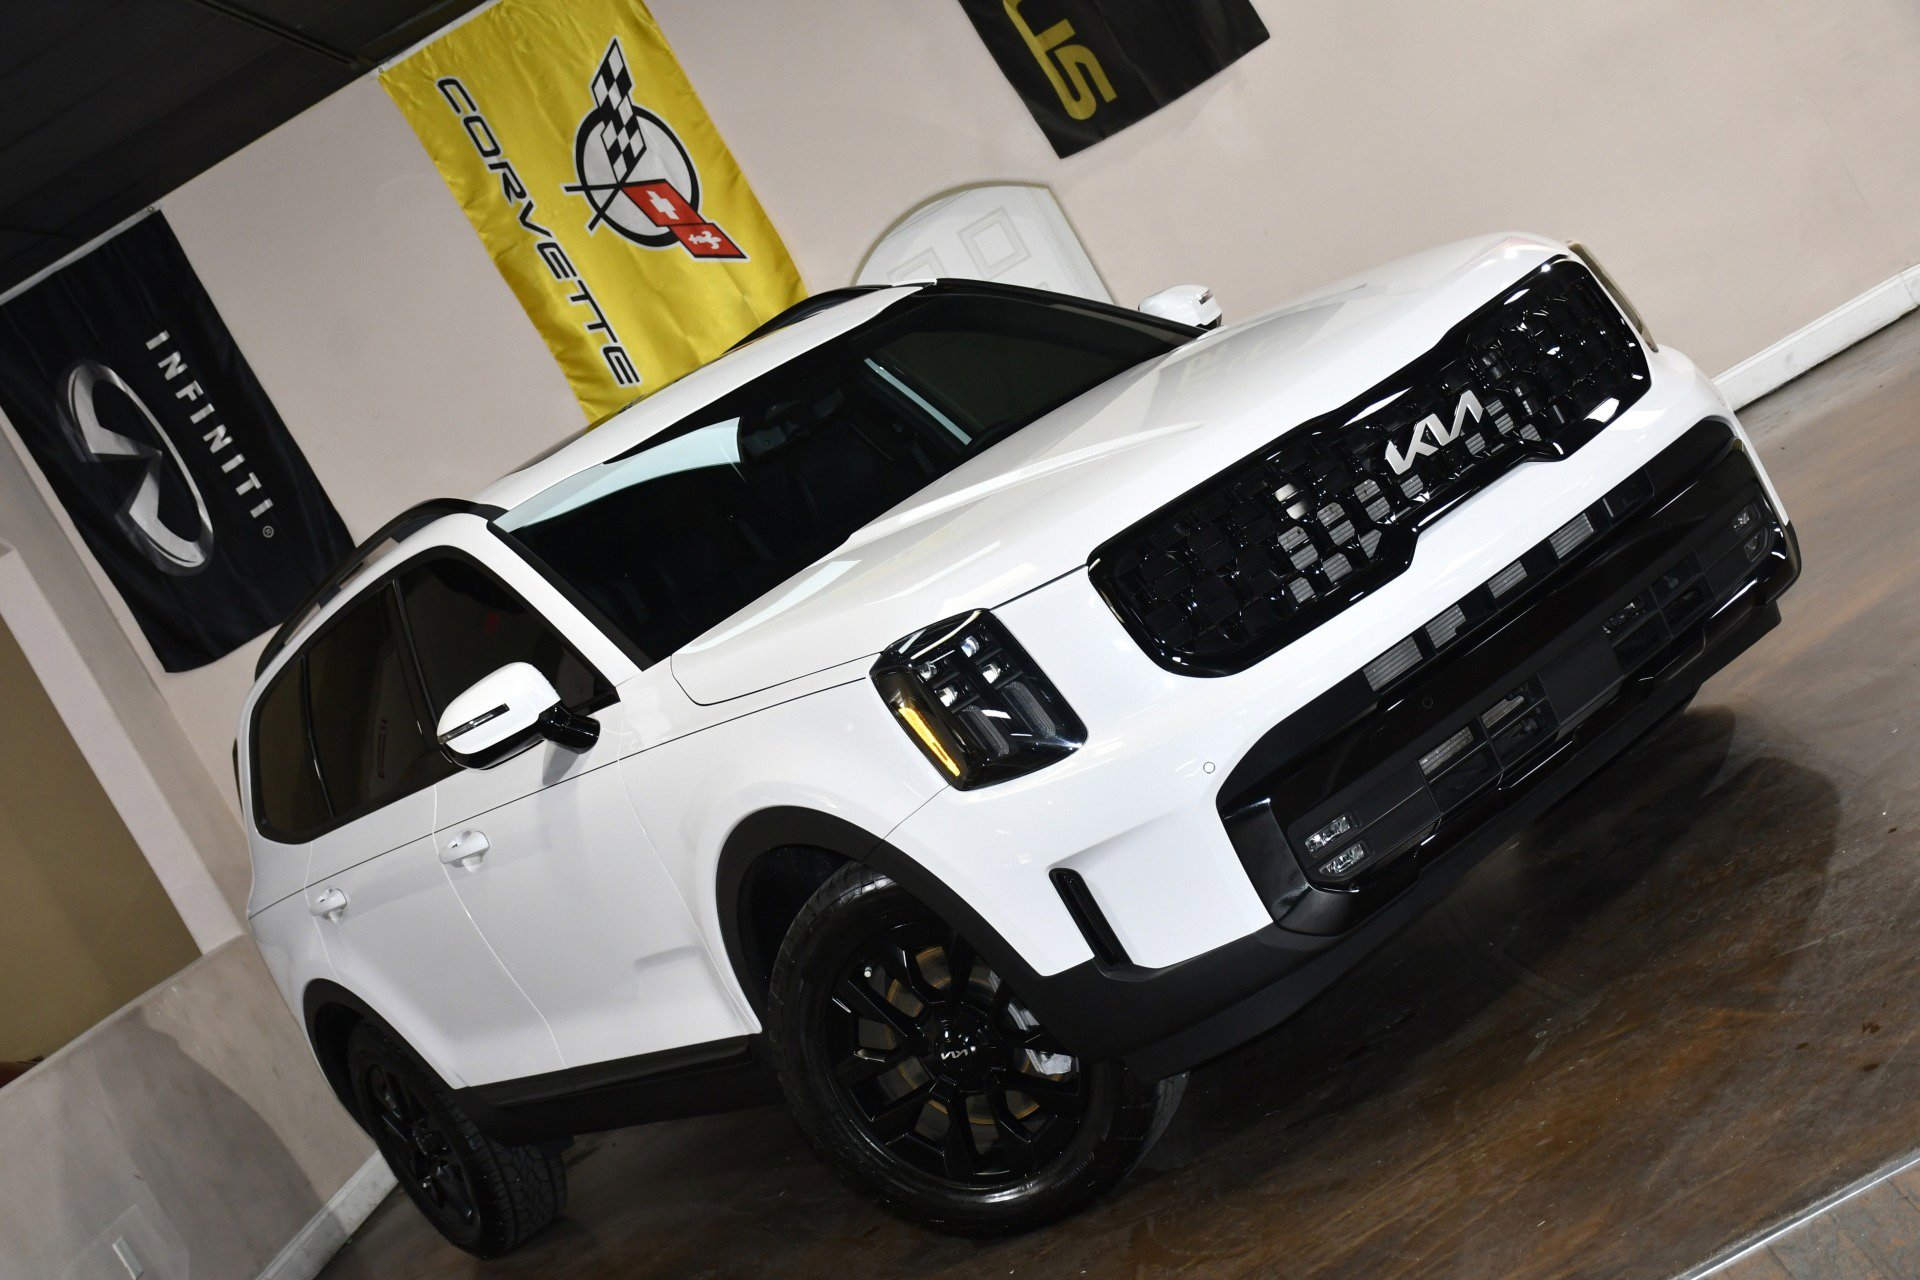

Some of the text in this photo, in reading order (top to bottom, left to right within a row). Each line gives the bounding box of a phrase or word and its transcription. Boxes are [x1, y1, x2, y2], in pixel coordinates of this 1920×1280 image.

[435, 77, 641, 387] CORVETTE
[145, 330, 274, 519] INFINITI
[1385, 389, 1484, 475] KIA
